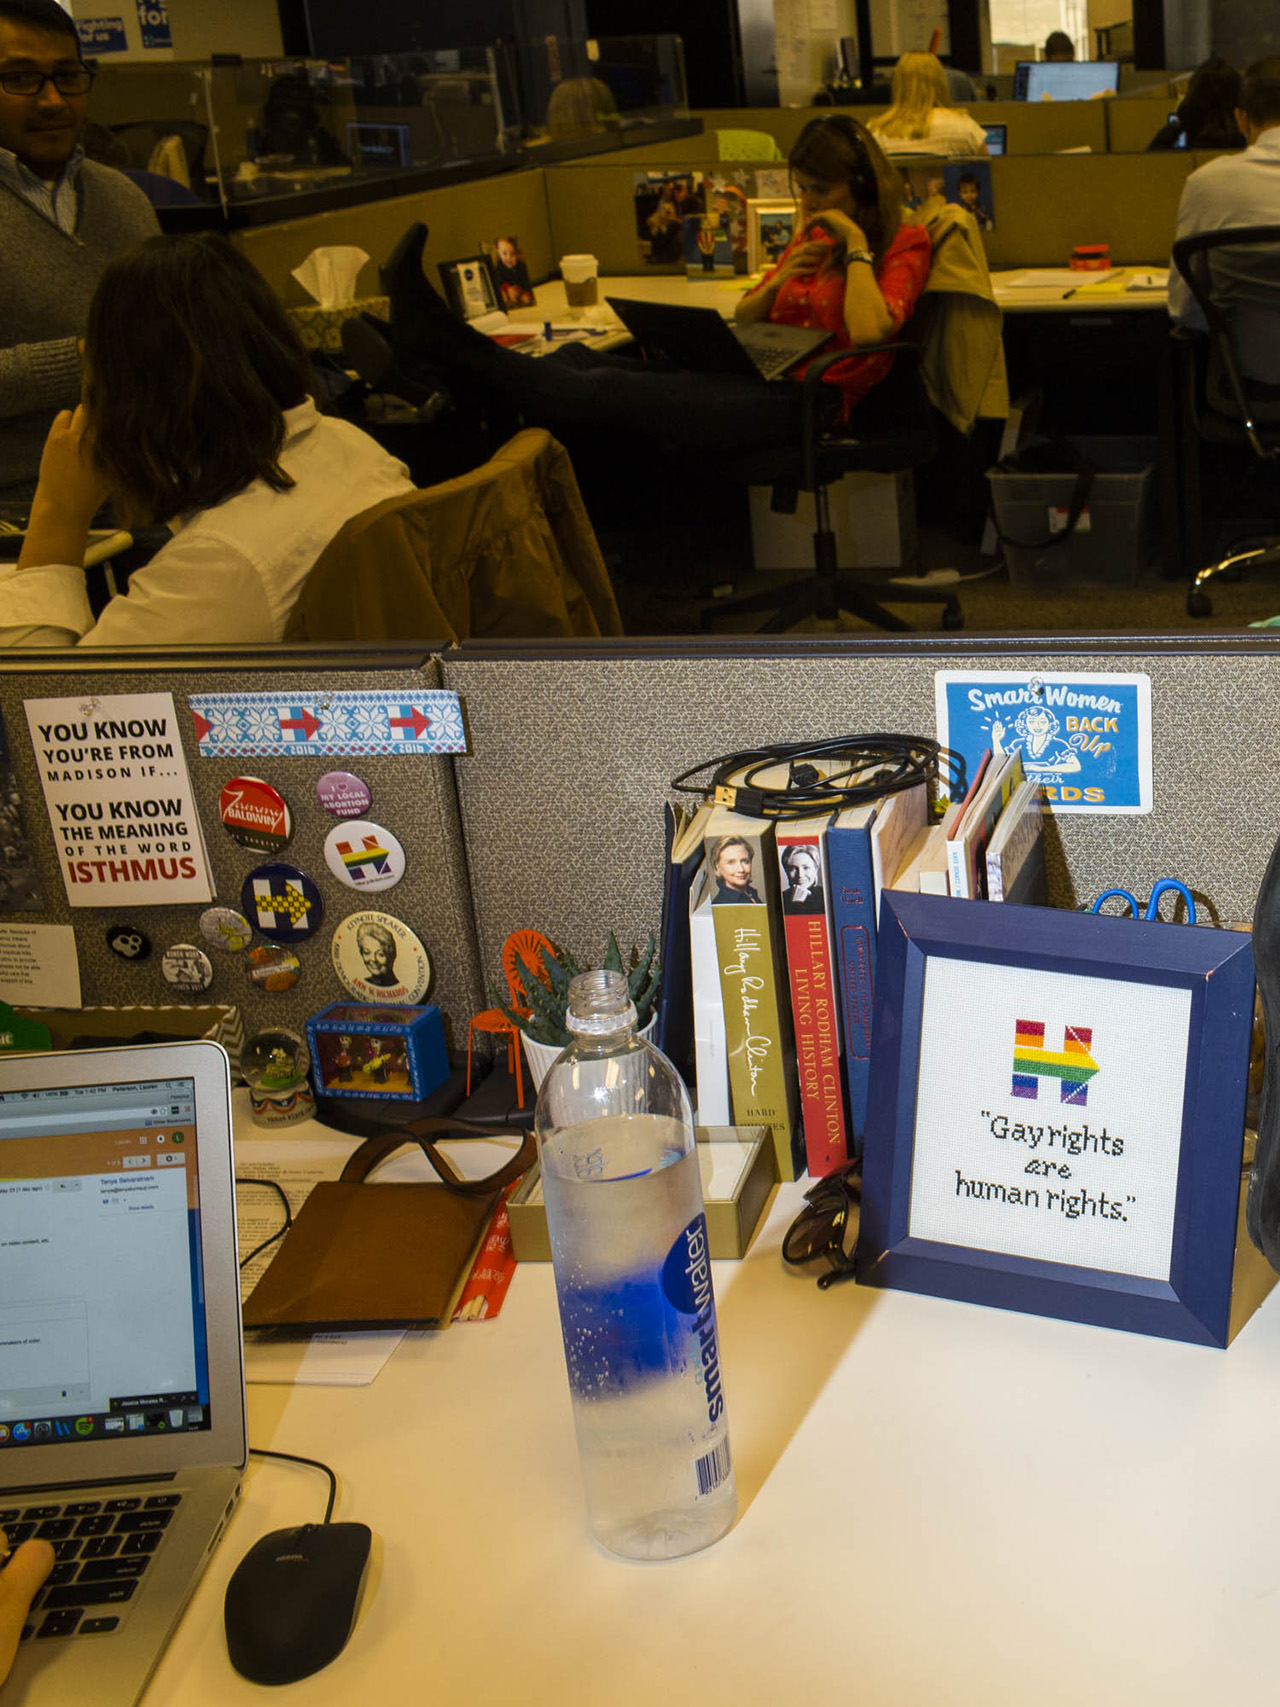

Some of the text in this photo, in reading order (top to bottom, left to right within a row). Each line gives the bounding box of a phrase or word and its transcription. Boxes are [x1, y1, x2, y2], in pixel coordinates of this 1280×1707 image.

[1045, 685, 1122, 714] Women
[38, 719, 167, 743] YOU KNOW
[1066, 716, 1119, 733] BACK
[43, 744, 174, 764] YOU'RE FROM
[1069, 733, 1112, 759] Up
[47, 765, 178, 782] MADISON IF...
[1027, 771, 1065, 784] their
[321, 791, 366, 802] MY LOCAL
[323, 799, 369, 809] ABORTION
[55, 799, 182, 822] YOU KNOW
[228, 806, 276, 826] BALDWIN
[336, 807, 361, 816] FUND
[60, 821, 188, 841] THE MEANING
[64, 841, 191, 857] OF THE WORD
[67, 856, 197, 884] ISTHMUS
[795, 968, 820, 1101] LIVING HISTORY
[808, 920, 841, 1145] HILLARY RODHAM CLINTON
[1047, 1124, 1125, 1157] rights
[1024, 1158, 1073, 1180] are
[955, 1169, 1040, 1208] human
